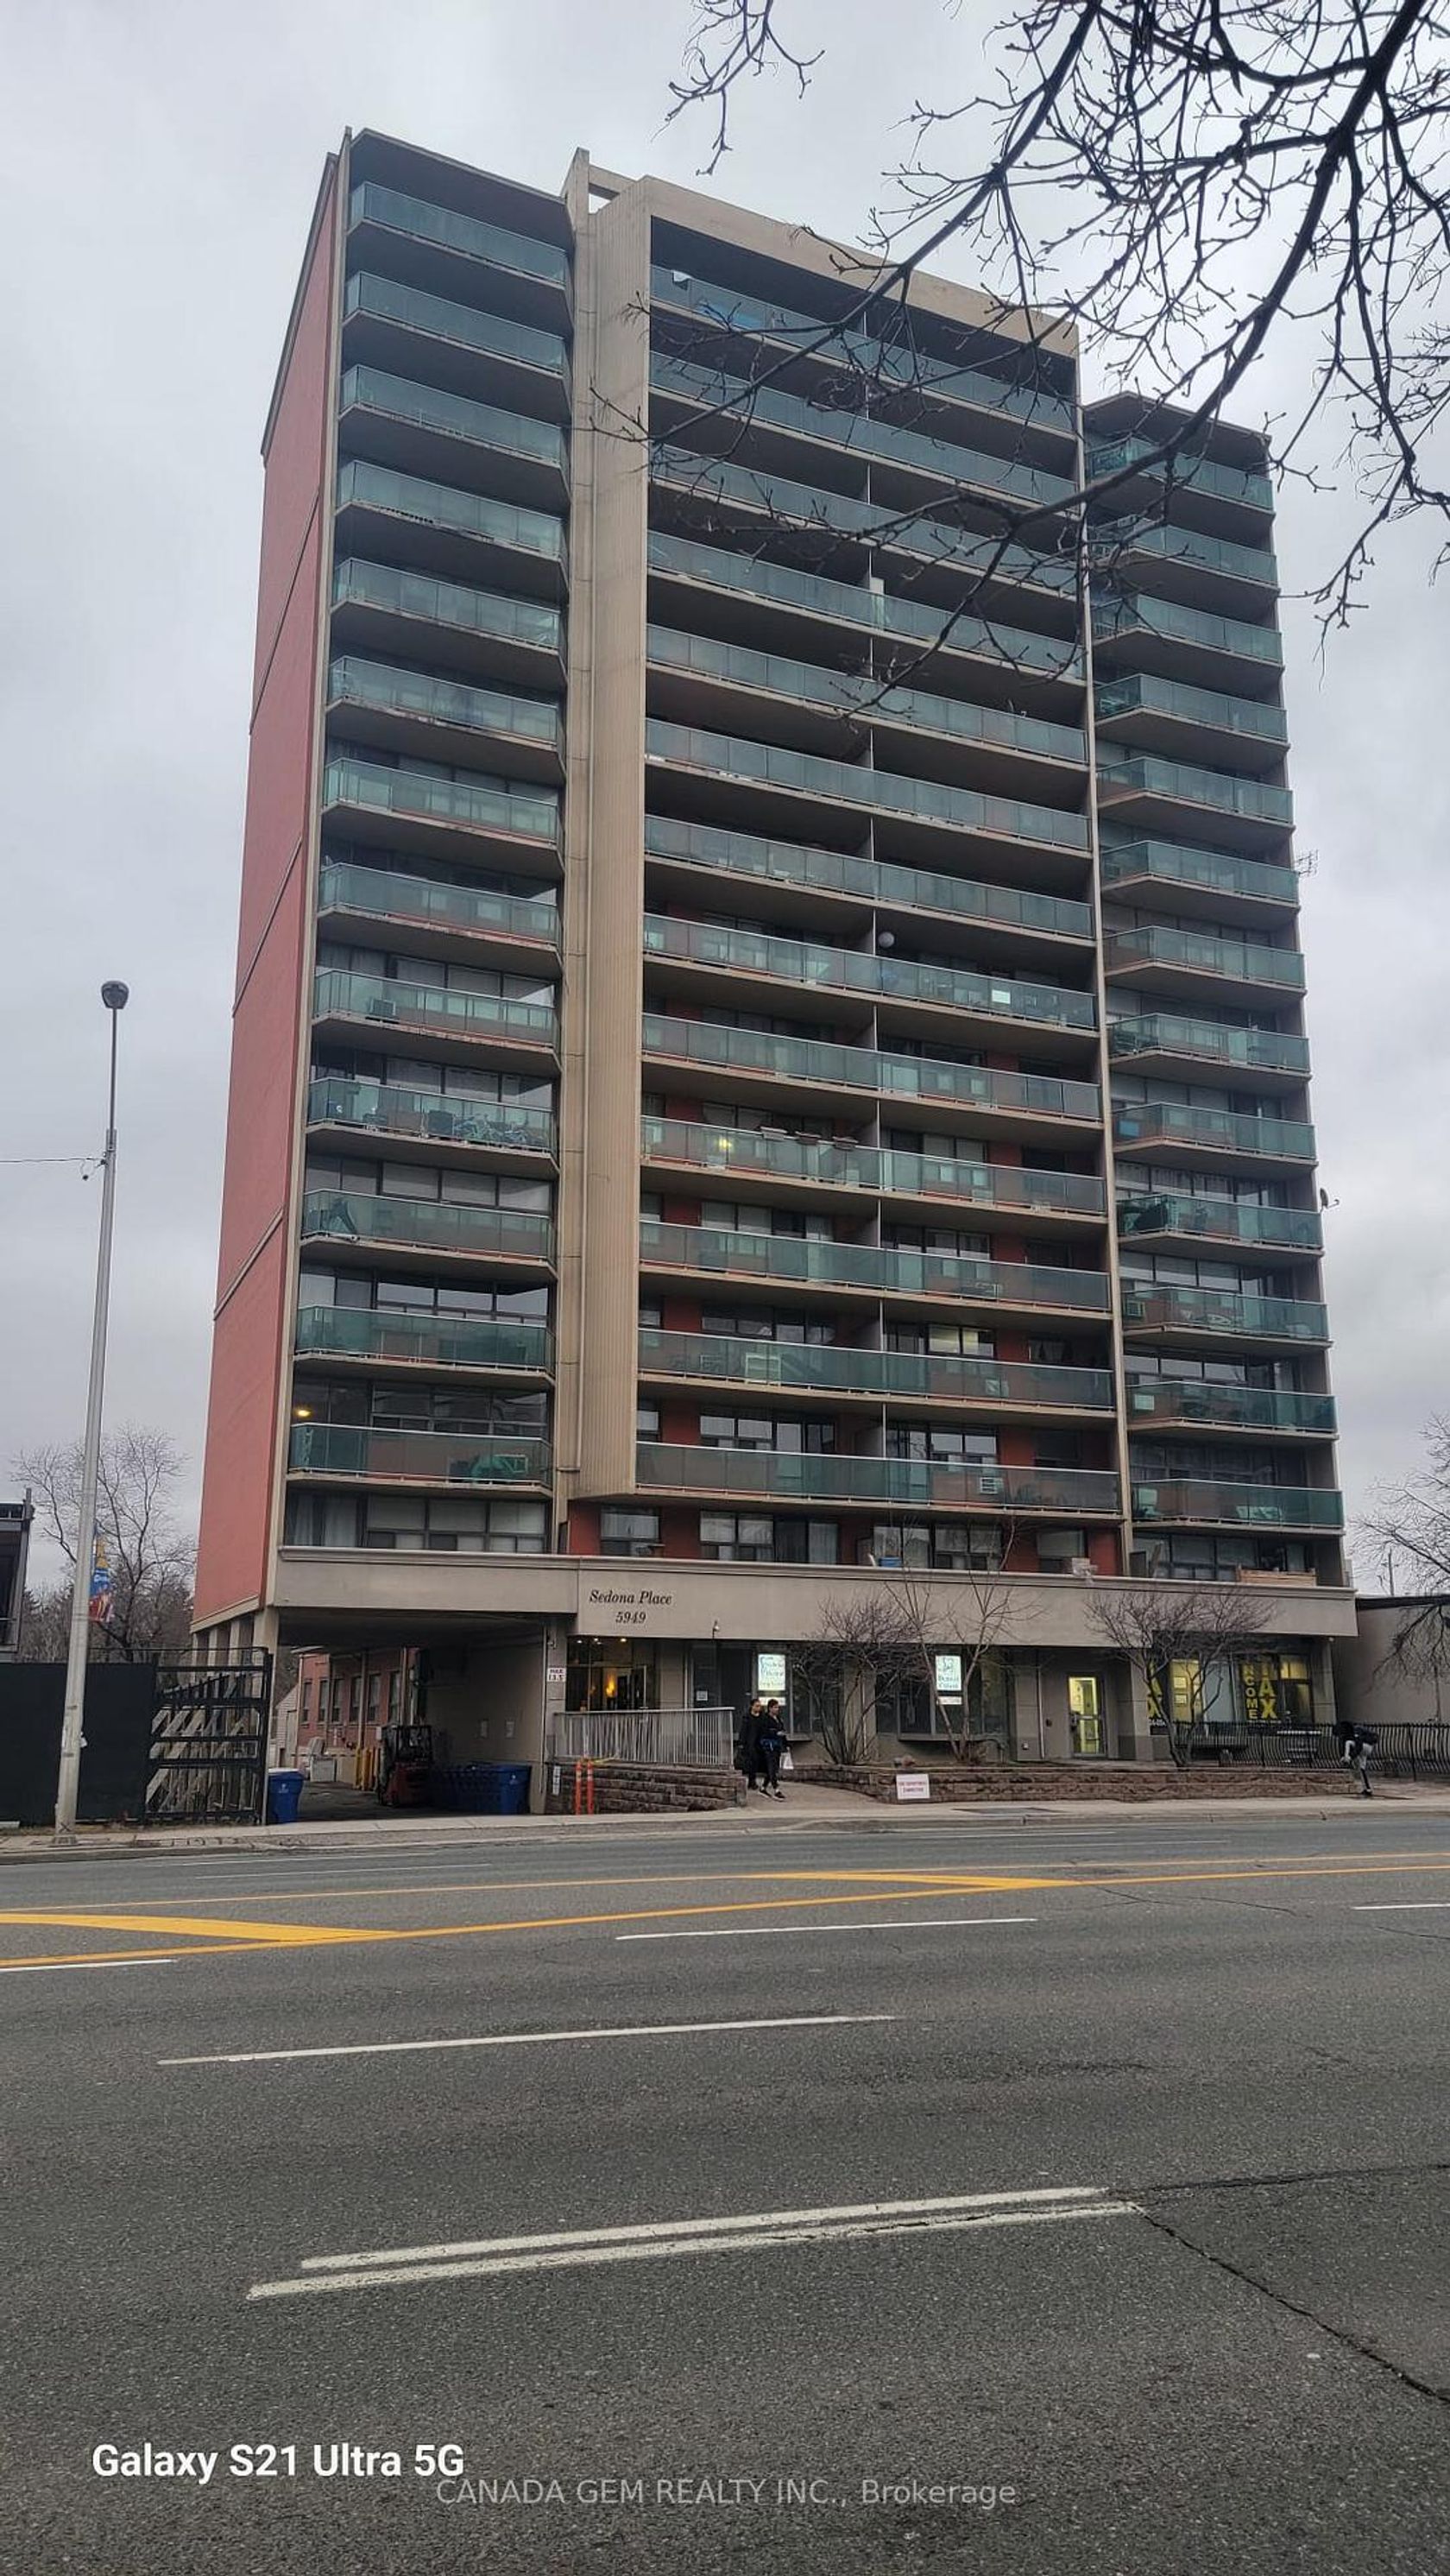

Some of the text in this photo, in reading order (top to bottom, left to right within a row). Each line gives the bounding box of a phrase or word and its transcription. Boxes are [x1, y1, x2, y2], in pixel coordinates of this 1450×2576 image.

[589, 1589, 672, 1605] Sedona Place
[615, 1611, 646, 1624] 5949
